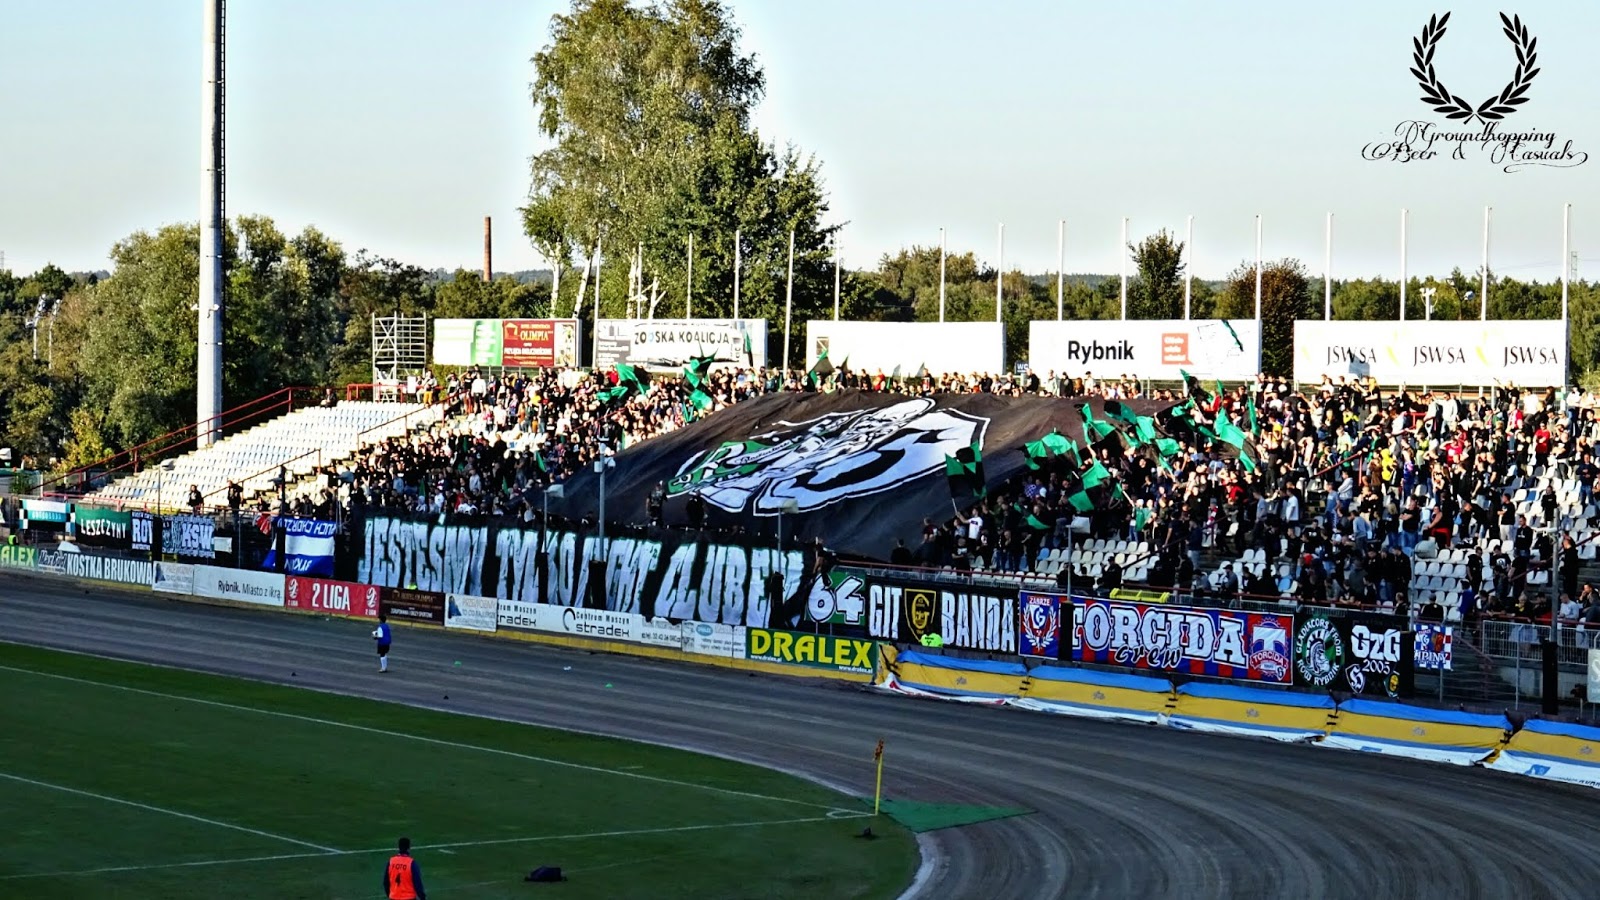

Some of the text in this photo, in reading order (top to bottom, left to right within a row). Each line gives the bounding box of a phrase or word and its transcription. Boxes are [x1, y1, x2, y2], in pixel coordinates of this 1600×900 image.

[679, 331, 730, 345] KOALICJA
[1067, 339, 1135, 360] Rybnik
[1413, 345, 1466, 367] JSW SA
[1503, 345, 1558, 368] JSW SA
[80, 518, 126, 539] LESZCZYNY
[67, 553, 153, 585] KOSTKA BRUKOWA
[357, 513, 488, 597] JESTEŚMY
[807, 576, 865, 624] 64
[218, 580, 241, 594] Rybnik.
[242, 583, 263, 598] Miasto
[311, 583, 351, 611] 2 LIGA
[576, 611, 603, 622] Centrum
[605, 614, 630, 625] Maszyn
[868, 583, 903, 640] GIT
[940, 591, 1015, 652] BANDA
[576, 621, 630, 638] stradex
[751, 629, 873, 669] DRALEX
[1252, 651, 1284, 666] TORCIDA
[1296, 658, 1340, 686] ROW RYBNIK
[1362, 659, 1391, 675] 2005
[392, 863, 407, 871] FOTO
